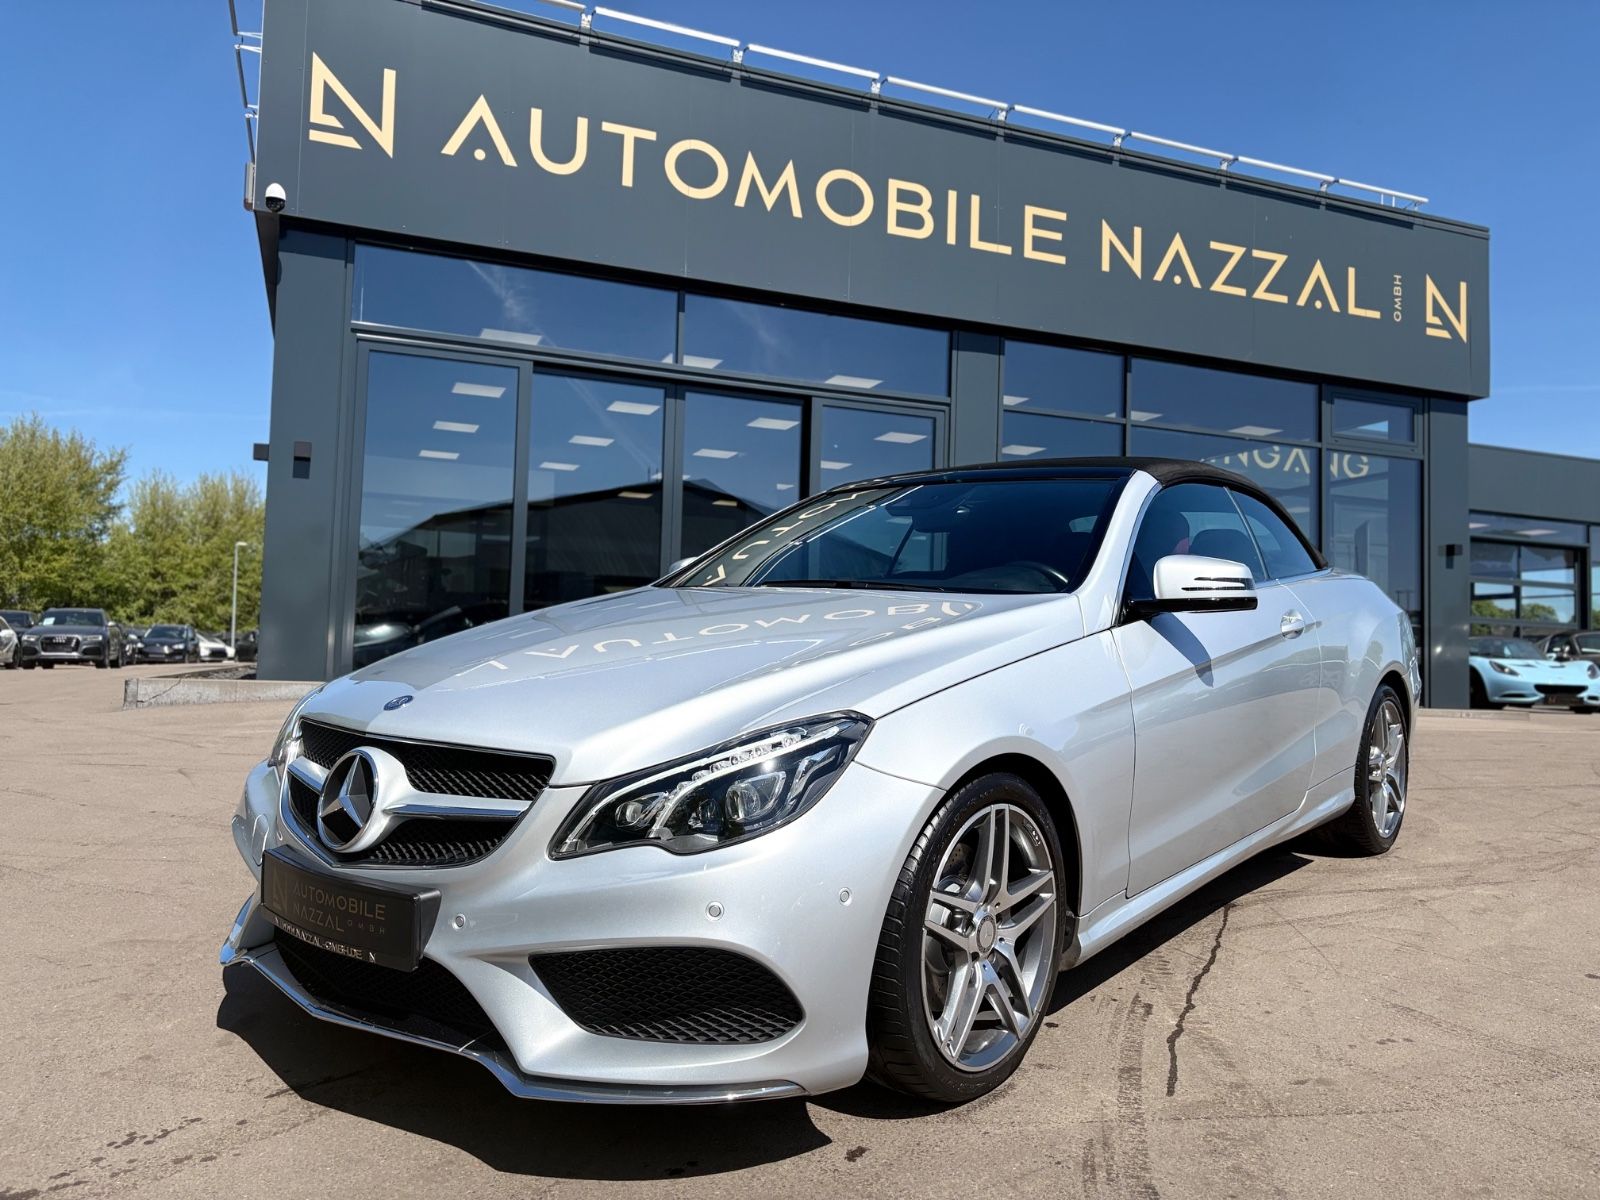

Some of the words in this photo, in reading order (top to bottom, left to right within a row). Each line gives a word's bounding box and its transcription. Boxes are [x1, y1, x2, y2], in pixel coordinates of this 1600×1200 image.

[440, 94, 1068, 266] AUTOMOBILE
[1101, 218, 1381, 320] NAZZAL
[1392, 273, 1404, 323] GMBH
[293, 883, 387, 920] AUTOMOBILE
[293, 903, 345, 933] NAZZAL
